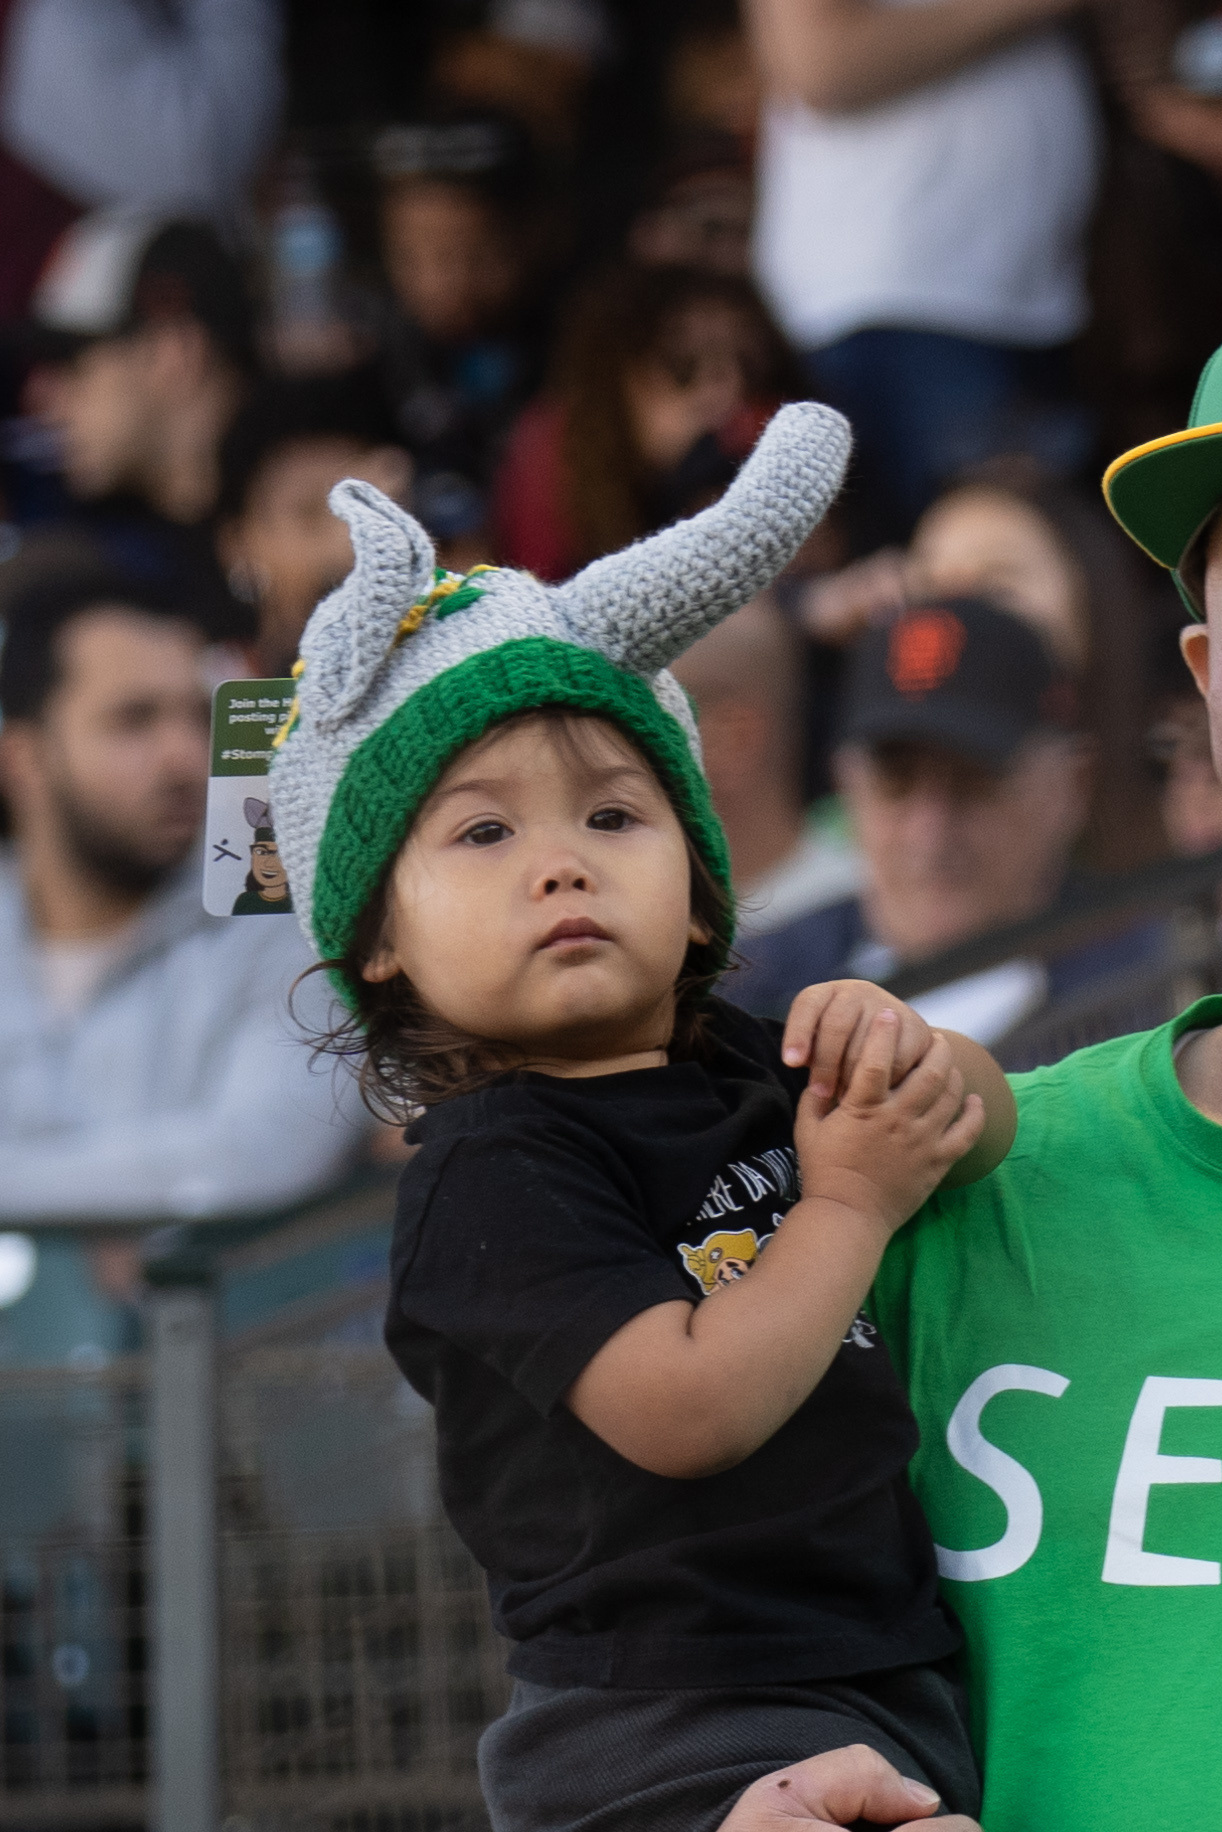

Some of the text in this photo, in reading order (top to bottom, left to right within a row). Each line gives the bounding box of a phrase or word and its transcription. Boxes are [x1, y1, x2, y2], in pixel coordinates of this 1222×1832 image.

[228, 699, 256, 708] Join
[258, 697, 280, 708] the
[228, 712, 277, 724] posting
